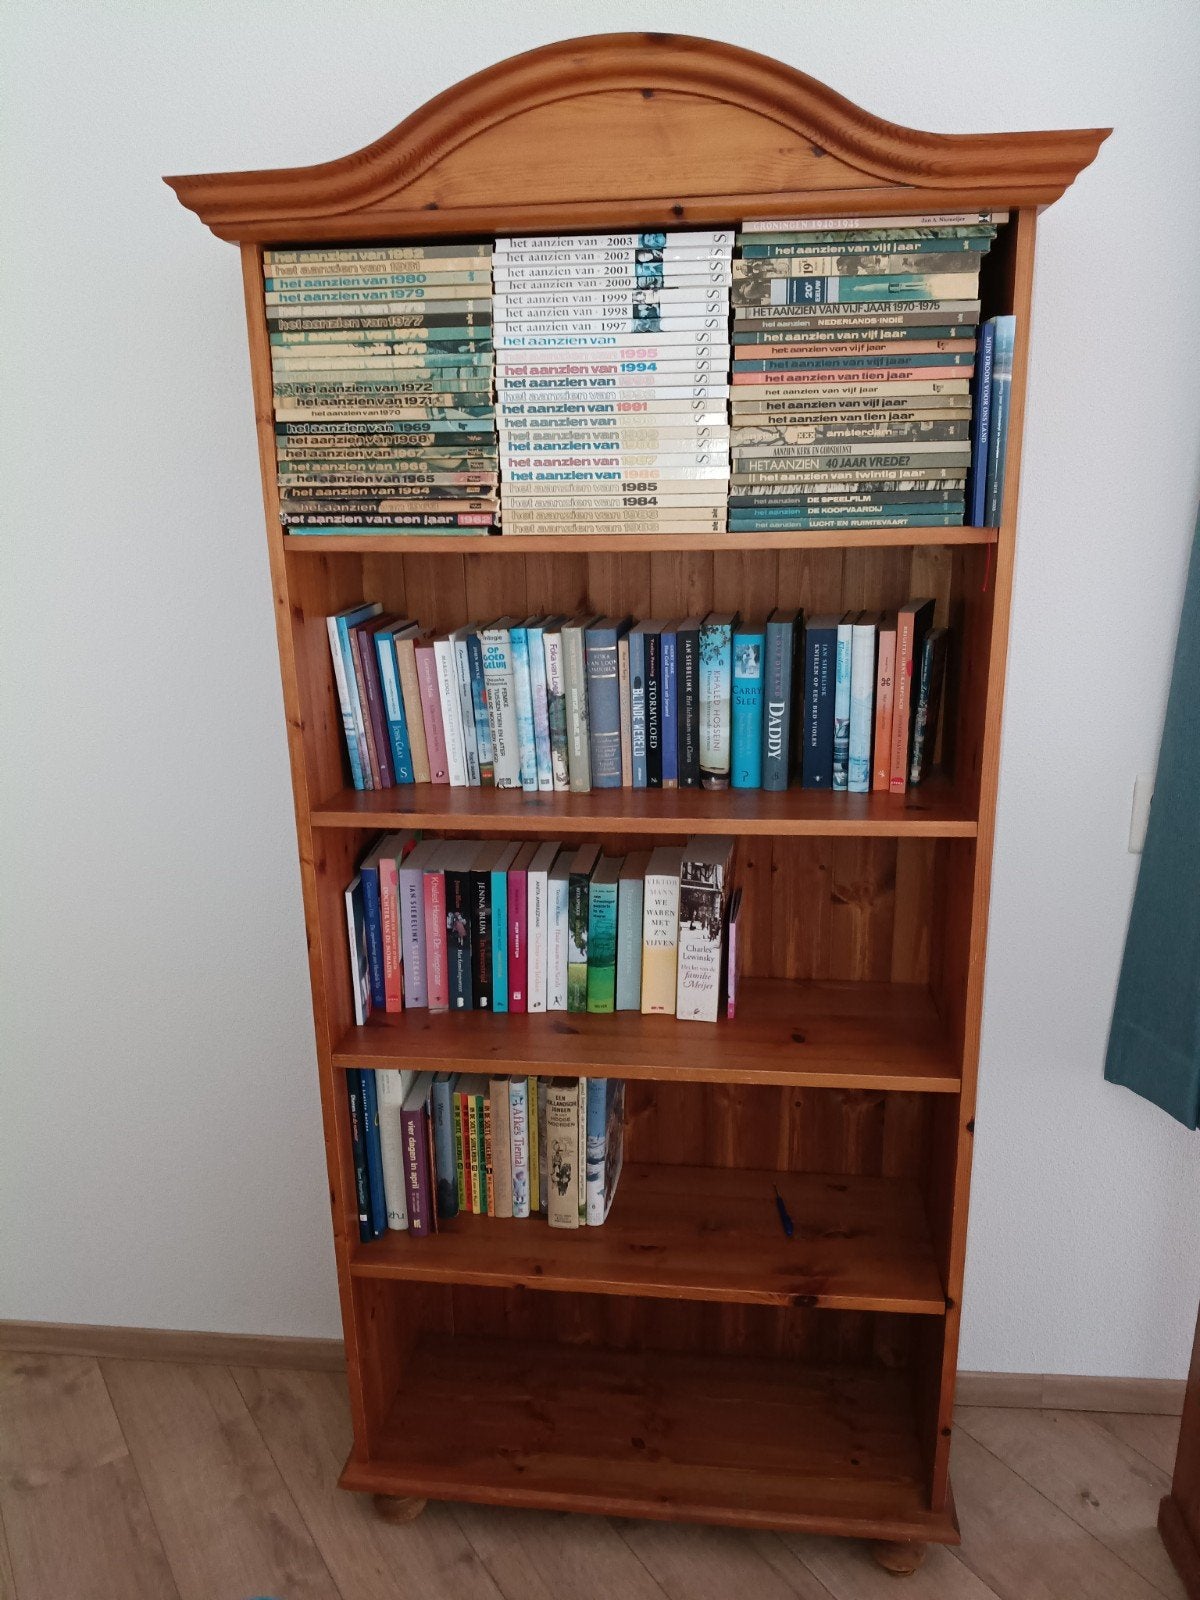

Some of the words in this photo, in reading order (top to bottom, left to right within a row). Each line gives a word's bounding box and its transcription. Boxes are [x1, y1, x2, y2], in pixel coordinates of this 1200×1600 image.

[754, 220, 807, 231] GRONINGEN
[511, 238, 527, 248] het
[532, 237, 574, 247] aanzien
[607, 238, 633, 246] 2003
[775, 245, 794, 255] het
[796, 244, 847, 254] aanzien
[849, 245, 869, 253] van
[892, 242, 921, 252] jaar
[507, 252, 522, 262] het
[527, 252, 569, 262] aanzien
[574, 253, 594, 261] van
[604, 252, 629, 261] 2002
[508, 267, 524, 277] het
[528, 266, 570, 276] aanzien
[604, 266, 628, 275] 2001
[279, 279, 300, 288] het
[304, 277, 360, 288] aanzien
[362, 277, 388, 286] van
[391, 274, 426, 283] 1980
[279, 293, 300, 302] het
[303, 291, 360, 301] aanzien
[361, 290, 388, 300] van
[391, 288, 424, 298] 1979
[505, 294, 521, 304] het
[526, 293, 568, 304] aanzien
[602, 294, 627, 302] 1999
[506, 308, 522, 318] het
[527, 307, 569, 317] aanzien
[602, 307, 628, 316] 1998
[753, 307, 771, 317] HET
[772, 305, 817, 316] AANZIEN
[818, 304, 840, 314] VAN
[842, 303, 862, 313] VIJF
[863, 302, 891, 312] JAAR
[893, 301, 940, 312] 1970-1975
[505, 322, 522, 332] het
[527, 321, 568, 331] aanzien
[601, 322, 626, 331] 1997
[764, 332, 783, 341] het
[785, 332, 837, 340] aanzien
[838, 332, 860, 340] van
[880, 330, 906, 340] jaar
[505, 365, 527, 375] het
[530, 364, 590, 375] aanzien
[592, 365, 617, 373] van
[620, 362, 657, 372] 1994
[984, 356, 992, 383] DROOM
[765, 374, 784, 382] het
[787, 373, 838, 382] aanzien
[838, 373, 860, 381] van
[885, 371, 913, 381] jaar
[297, 397, 317, 407] het
[320, 396, 374, 406] aanzien
[376, 396, 403, 406] van
[405, 396, 432, 405] 1971
[502, 404, 524, 414] het
[527, 403, 585, 413] aanzien
[588, 403, 614, 412] van
[617, 402, 647, 412] 1991
[287, 423, 309, 433] het
[312, 423, 365, 433] aanzien
[368, 423, 394, 432] van
[400, 423, 431, 432] 1969
[750, 461, 770, 470] HET
[771, 459, 820, 470] AANZIEN
[826, 458, 838, 468] 40
[840, 457, 867, 468] JAAR
[869, 456, 910, 466] VREDE?
[297, 475, 317, 483] het
[319, 474, 372, 484] aanzien
[375, 474, 400, 483] van
[403, 474, 434, 483] 1965
[284, 514, 304, 524] het
[308, 514, 362, 524] aanzien
[365, 514, 391, 524] van
[395, 515, 422, 524] een
[424, 514, 453, 526] jaar
[487, 646, 500, 654] OP
[713, 670, 721, 705] KHALED
[813, 677, 819, 687] OP
[732, 685, 762, 694] CARRY
[633, 688, 644, 722] BLINDE
[736, 696, 757, 706] SLEE
[649, 681, 657, 748] STORMVLOED
[713, 709, 721, 751] HOSSEINI
[768, 702, 785, 759] DADDY
[634, 724, 645, 756] WERELD
[477, 882, 486, 909] JENNA
[383, 887, 391, 918] DOCHTER
[410, 901, 418, 943] SIEBELINK
[385, 935, 391, 943] DE
[686, 945, 712, 953] Charles
[682, 953, 714, 962] Lewinsky
[683, 980, 713, 991] Meijer
[513, 1108, 523, 1135] Afke's
[408, 1137, 416, 1161] dagen
[514, 1137, 525, 1167] Tiental
[410, 1172, 419, 1189] april
